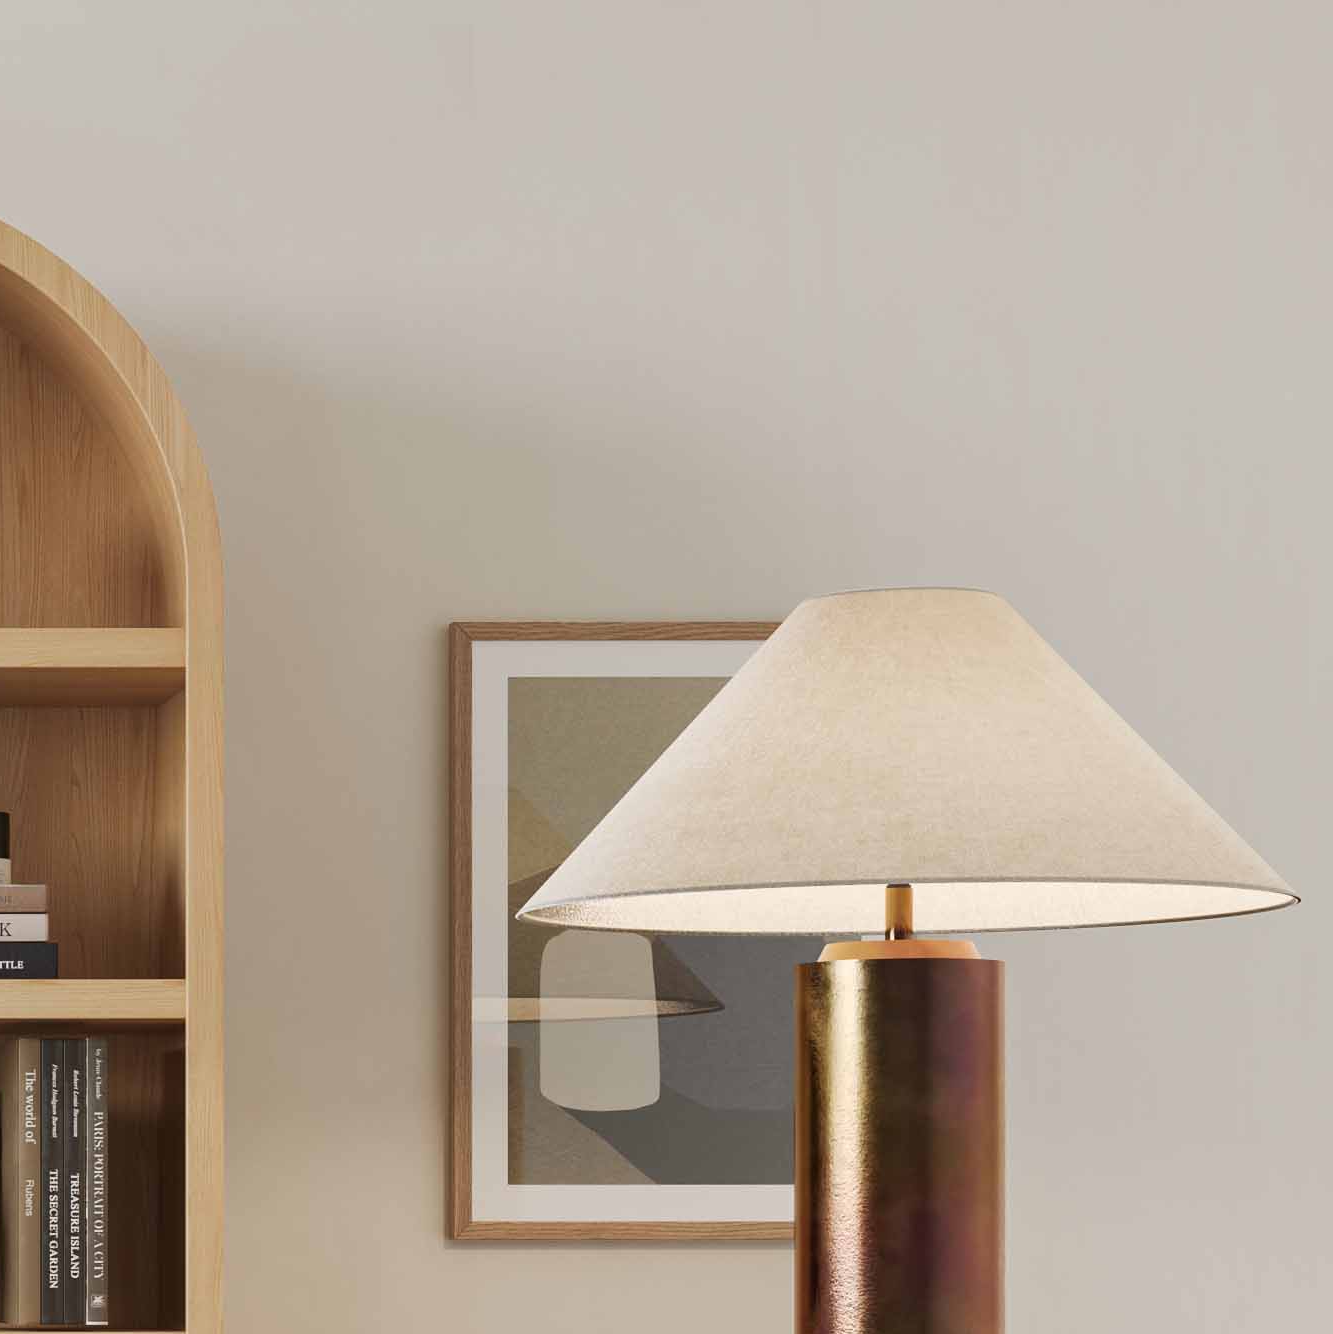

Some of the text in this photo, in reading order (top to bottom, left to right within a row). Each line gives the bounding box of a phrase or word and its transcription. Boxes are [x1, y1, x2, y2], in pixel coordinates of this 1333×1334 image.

[25, 1069, 36, 1144] The world of
[25, 1179, 35, 1217] Rubens
[49, 1169, 59, 1289] THE SECRET GARDEN
[70, 1173, 80, 1279] TREASURE ISLAND
[93, 1111, 104, 1280] PARIS: PORTRAIT OF A CITY
